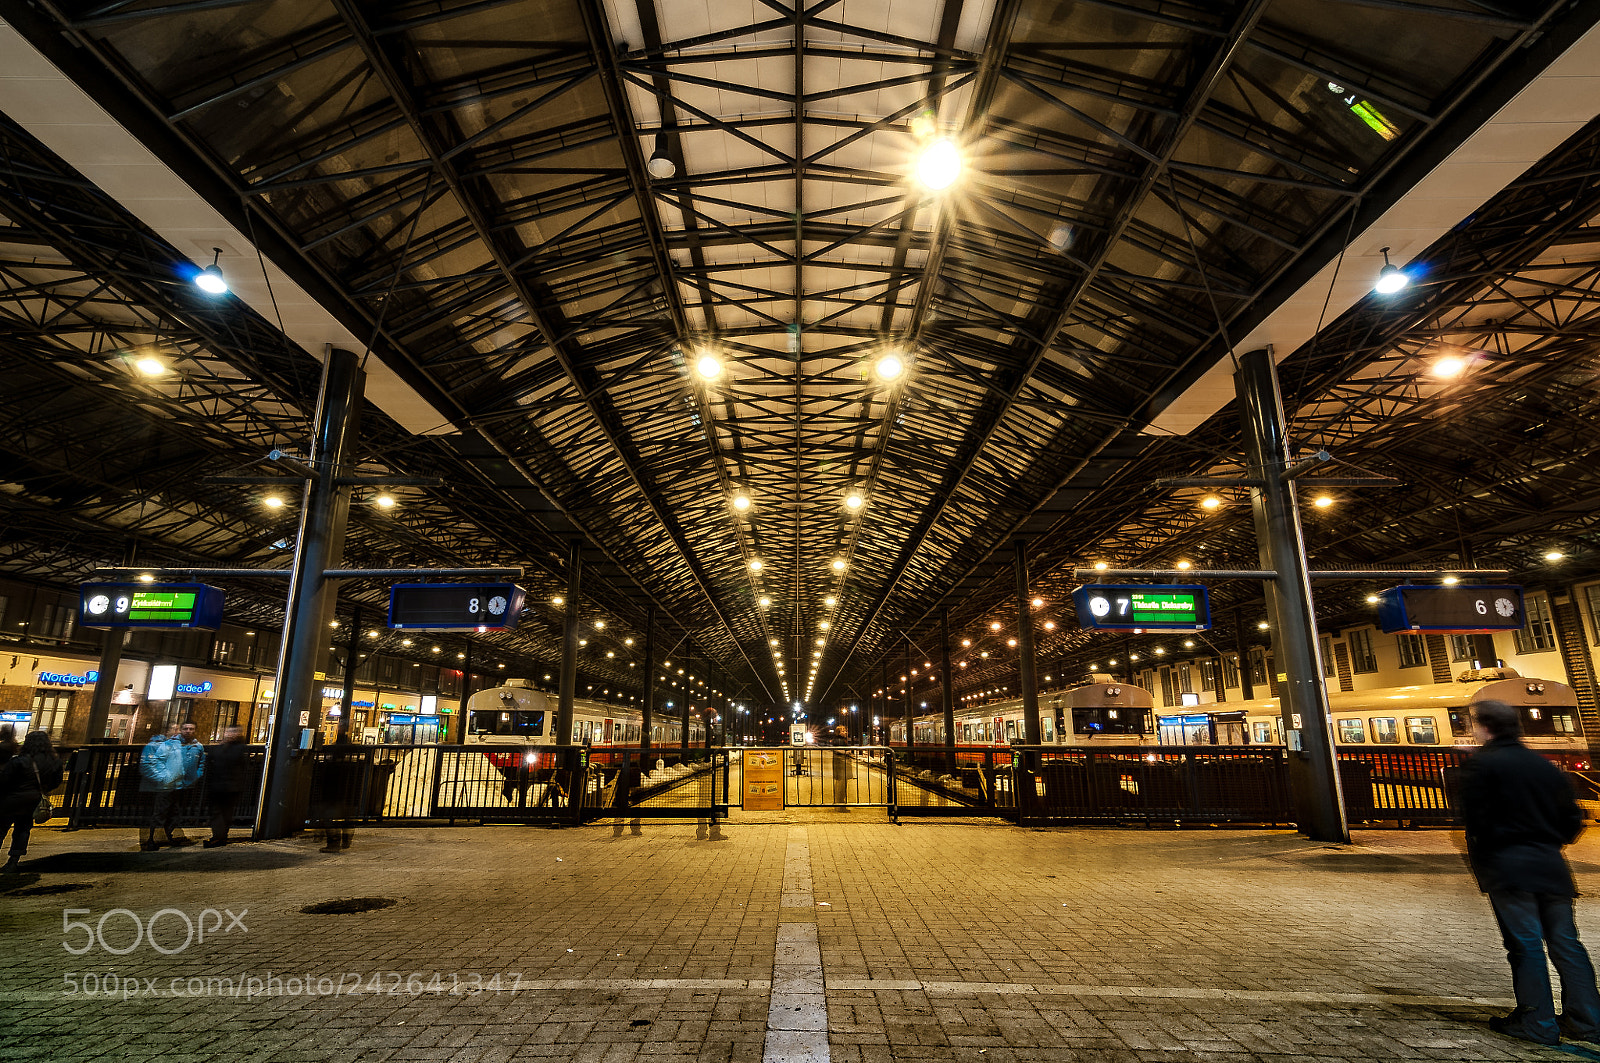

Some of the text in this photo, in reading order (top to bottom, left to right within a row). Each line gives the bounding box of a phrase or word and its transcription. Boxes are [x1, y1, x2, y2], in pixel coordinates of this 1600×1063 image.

[115, 597, 129, 613] 9
[469, 598, 479, 613] 8
[1117, 599, 1130, 615] 7
[1475, 600, 1487, 615] 6
[40, 671, 87, 684] Nordea
[177, 683, 204, 693] ordea
[1108, 710, 1118, 719] N
